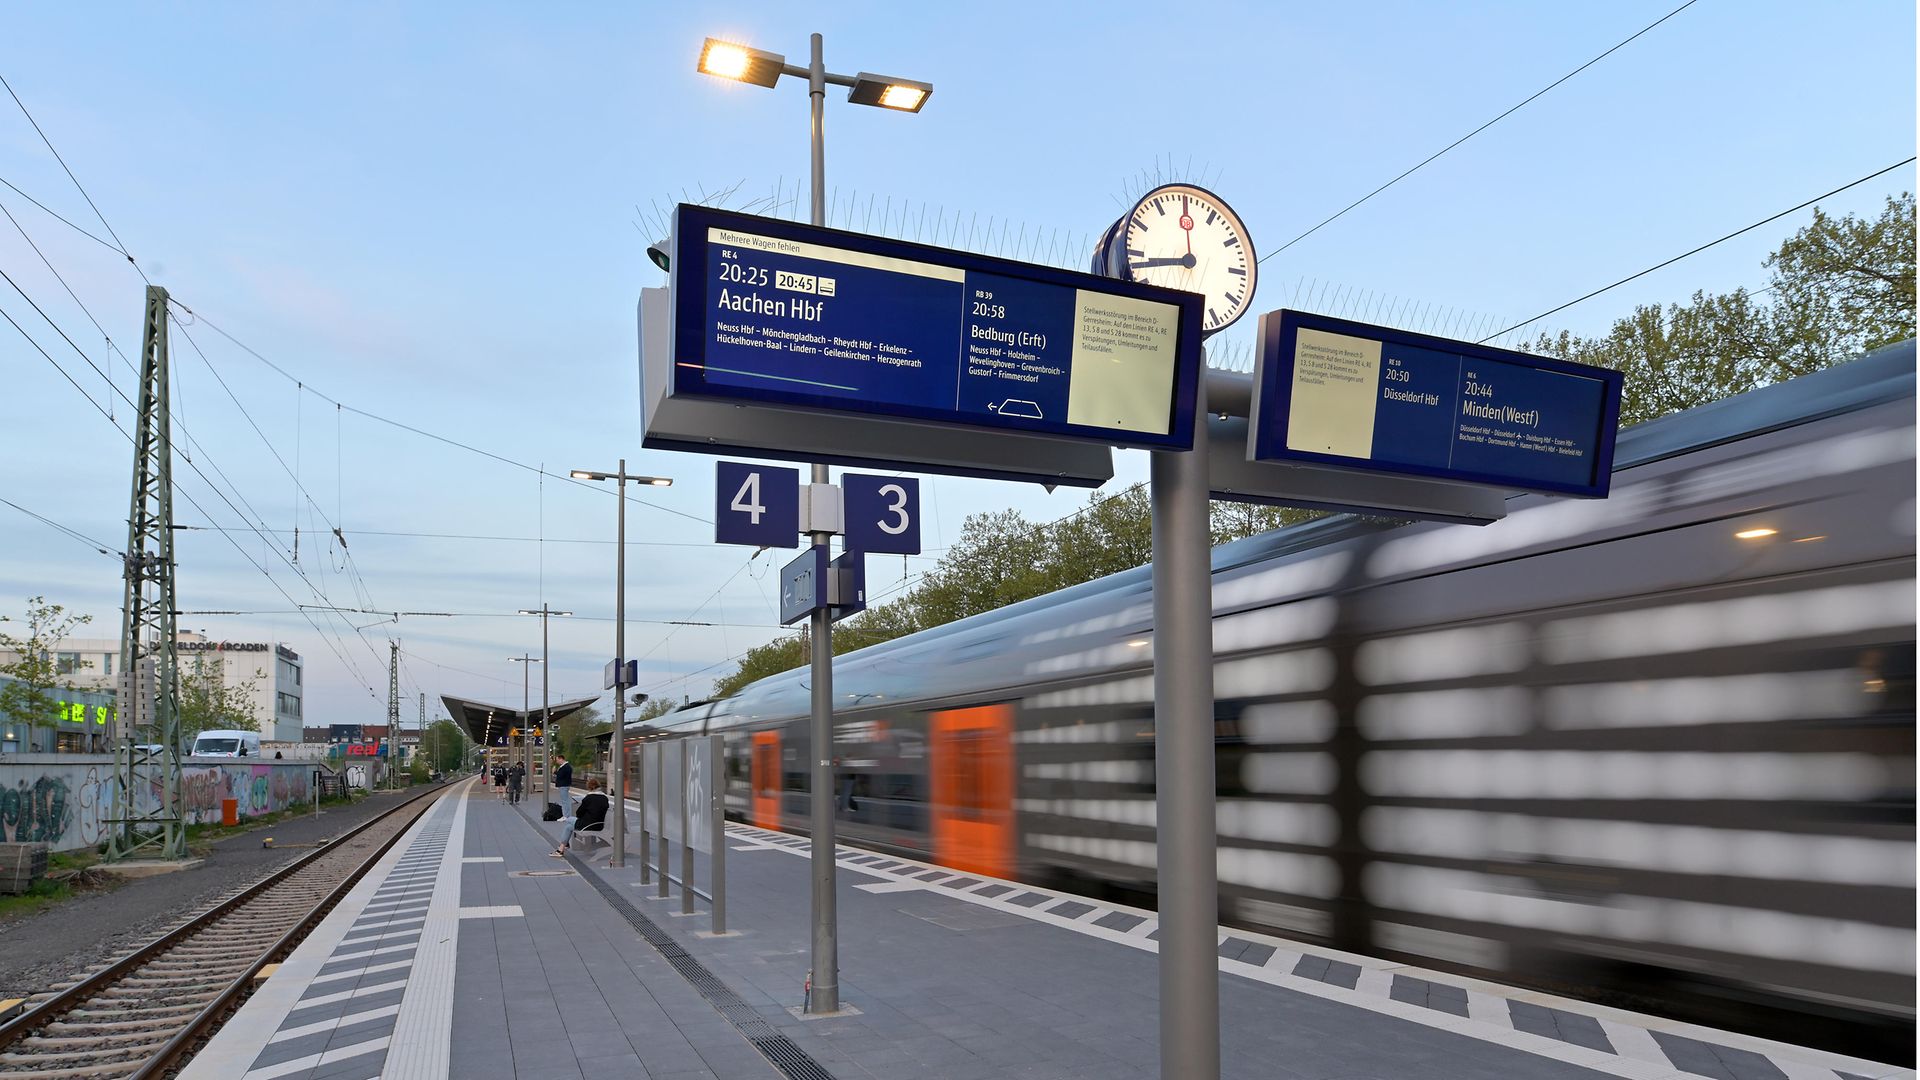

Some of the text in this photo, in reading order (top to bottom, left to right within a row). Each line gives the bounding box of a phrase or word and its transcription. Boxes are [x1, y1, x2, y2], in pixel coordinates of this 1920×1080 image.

[720, 232, 800, 252] Mehrere Wagen fehlen
[722, 250, 738, 260] RE 4
[719, 263, 813, 291] 20:25 20:45
[718, 288, 823, 322] Aachen Hbf
[972, 302, 1005, 318] 20:58
[1135, 314, 1152, 323] Bereich
[717, 321, 907, 354] Neuss Hbf Mönchengladbach Rheydt Hbf Erkelenz
[971, 324, 1046, 350] Bedburg (Erft)
[1122, 331, 1138, 340] kommt
[717, 334, 922, 368] Hückelhoven-Baal Lindern Geilenkirchen Herzogenrath
[970, 345, 1036, 361] Neuss Hbf Holzheim
[1118, 340, 1148, 350] Umleitungen
[968, 366, 1039, 382] Gustorf Frimmersdorf
[969, 356, 1060, 375] Wevelinghoven Grevenbroich
[1386, 368, 1410, 382] 20:50
[1384, 387, 1439, 406] Düsseldorf Hbf
[1464, 381, 1492, 398] 20:44
[1462, 400, 1539, 428] Minden(Westf)
[1460, 424, 1482, 434] Düsseldorf
[1494, 429, 1516, 438] Düsseldorf
[730, 472, 766, 525] 4
[877, 484, 909, 535] 3
[346, 738, 379, 756] real
